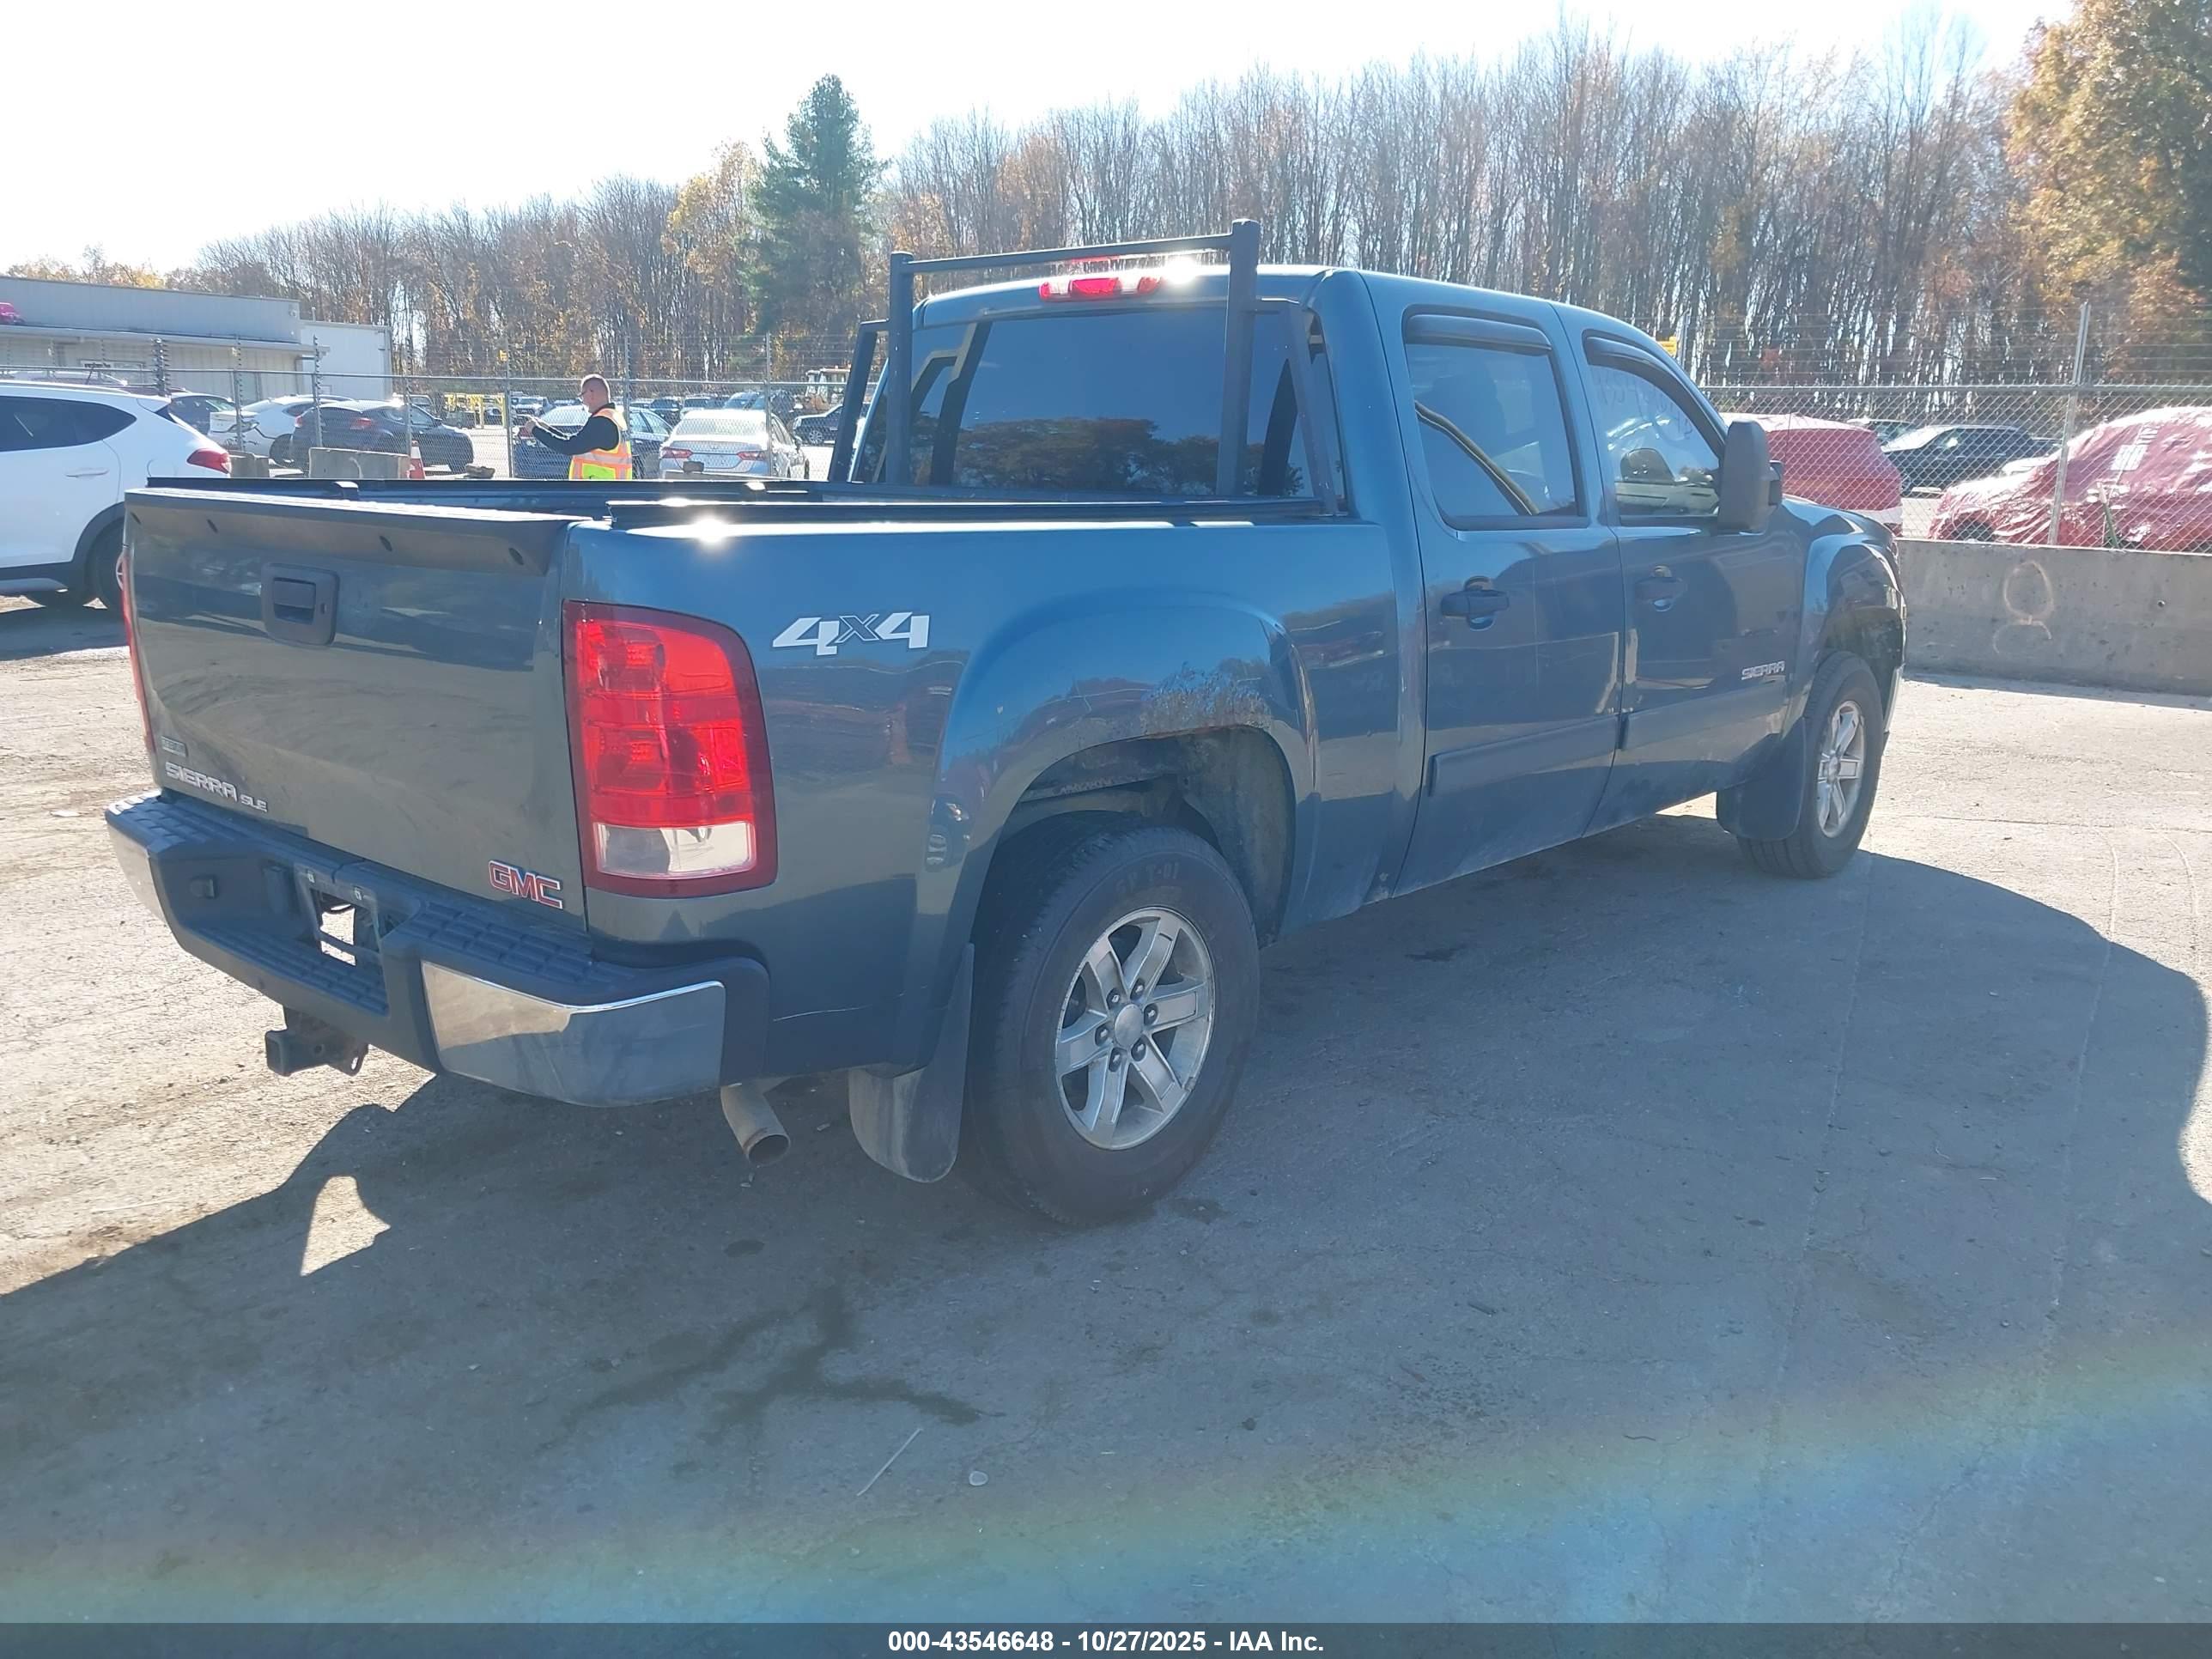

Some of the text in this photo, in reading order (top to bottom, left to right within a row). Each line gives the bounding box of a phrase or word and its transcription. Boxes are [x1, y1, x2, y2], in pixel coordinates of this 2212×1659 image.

[165, 762, 268, 813] SIERRA SLE
[488, 860, 563, 909] GMC
